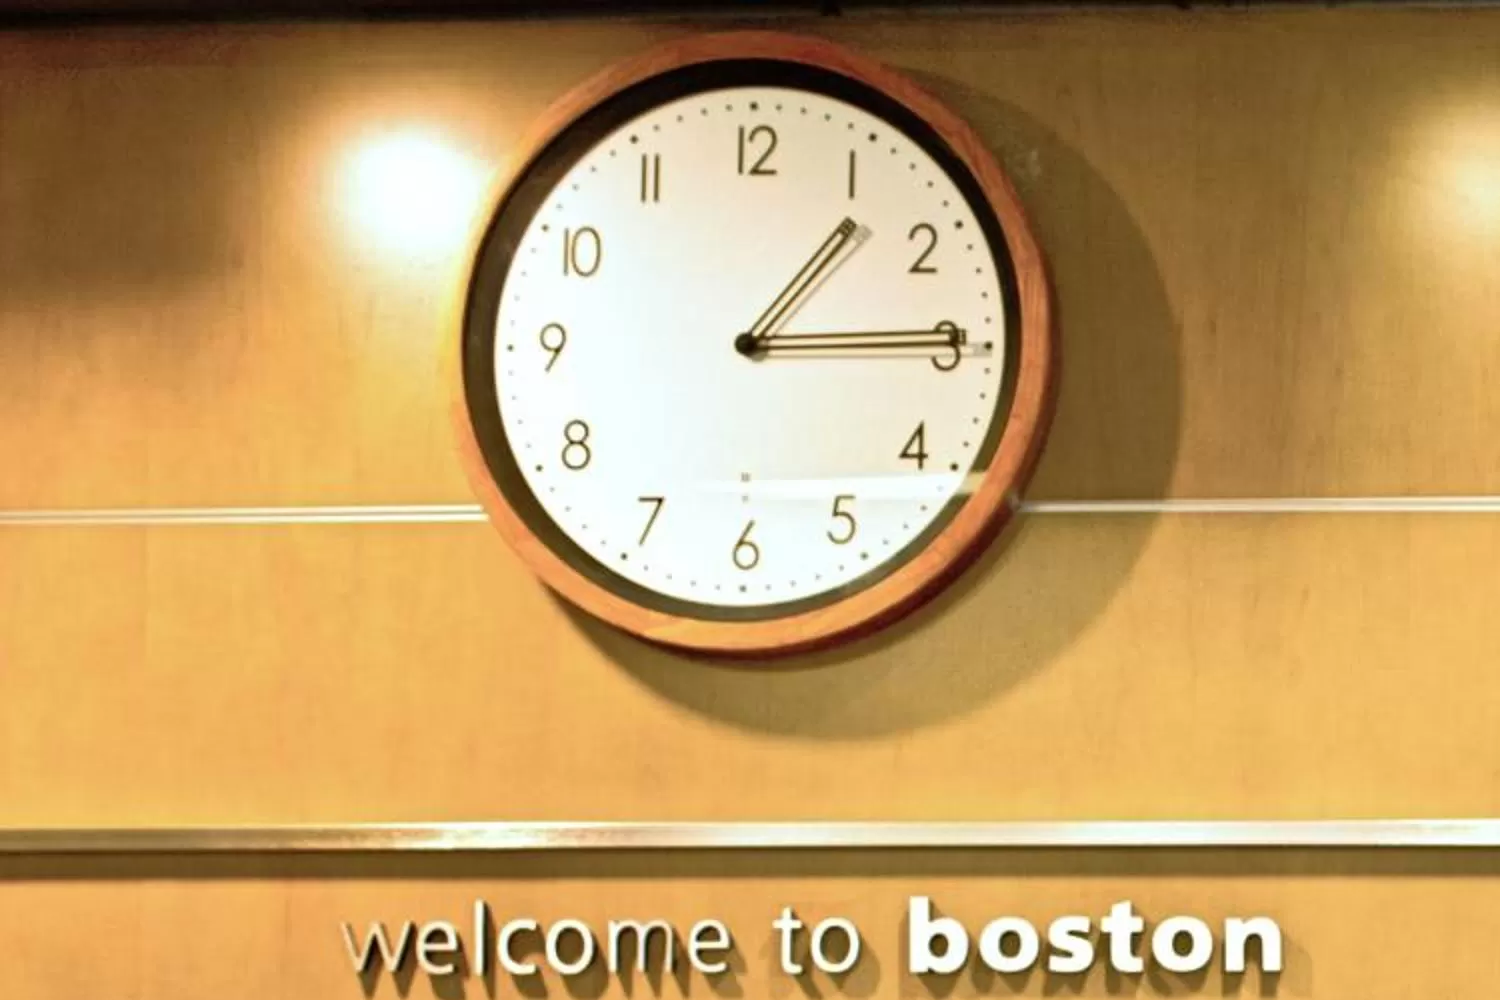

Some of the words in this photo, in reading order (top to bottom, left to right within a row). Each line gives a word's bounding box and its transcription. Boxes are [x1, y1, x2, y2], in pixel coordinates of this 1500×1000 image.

[737, 124, 779, 176] 12
[847, 149, 857, 200] 1
[640, 153, 661, 203] 11
[562, 226, 602, 278] 10
[907, 222, 938, 274] 2
[538, 322, 567, 373] 9
[930, 320, 962, 372] 3
[561, 419, 592, 471] 8
[898, 421, 929, 471] 4
[638, 497, 665, 547] 7
[731, 520, 761, 571] 6
[826, 494, 858, 546] 5
[340, 898, 732, 976] welcome
[772, 906, 860, 975] to
[908, 896, 1283, 974] boston
